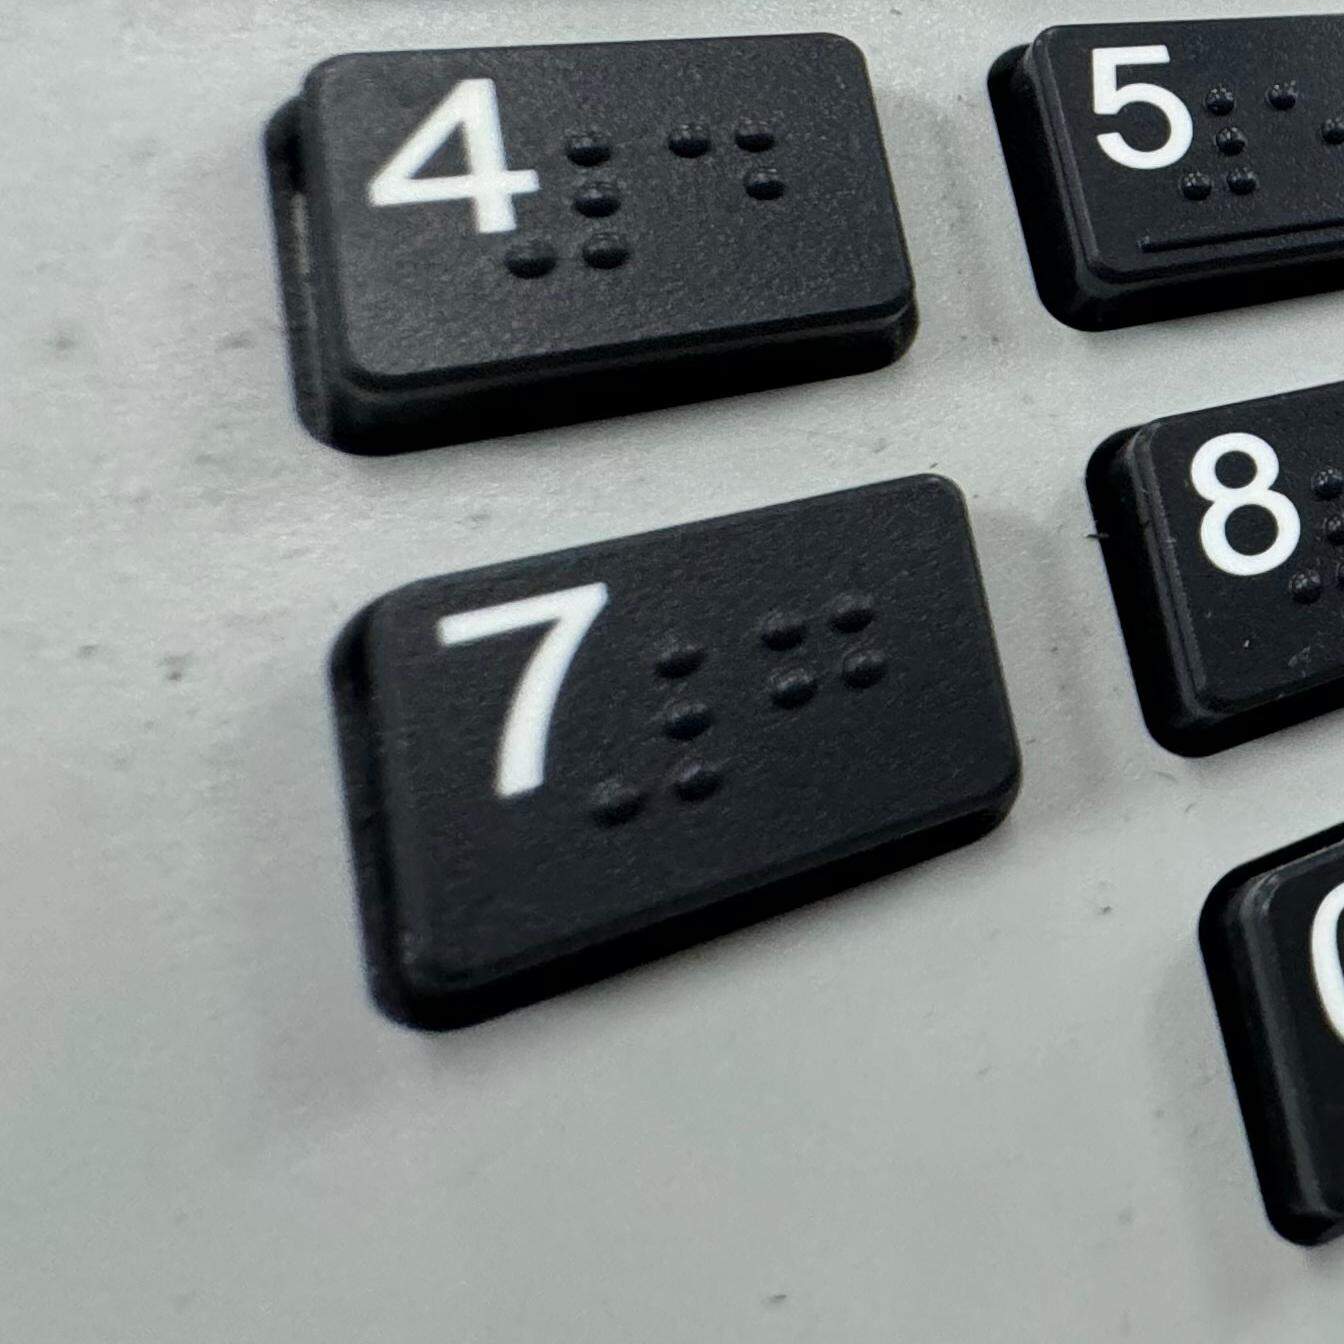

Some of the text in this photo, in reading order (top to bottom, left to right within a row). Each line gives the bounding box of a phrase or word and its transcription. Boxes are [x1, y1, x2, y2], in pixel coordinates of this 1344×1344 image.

[369, 79, 540, 234] 4
[1093, 45, 1192, 169] 5
[1190, 433, 1300, 575] 8
[437, 582, 607, 795] 7
